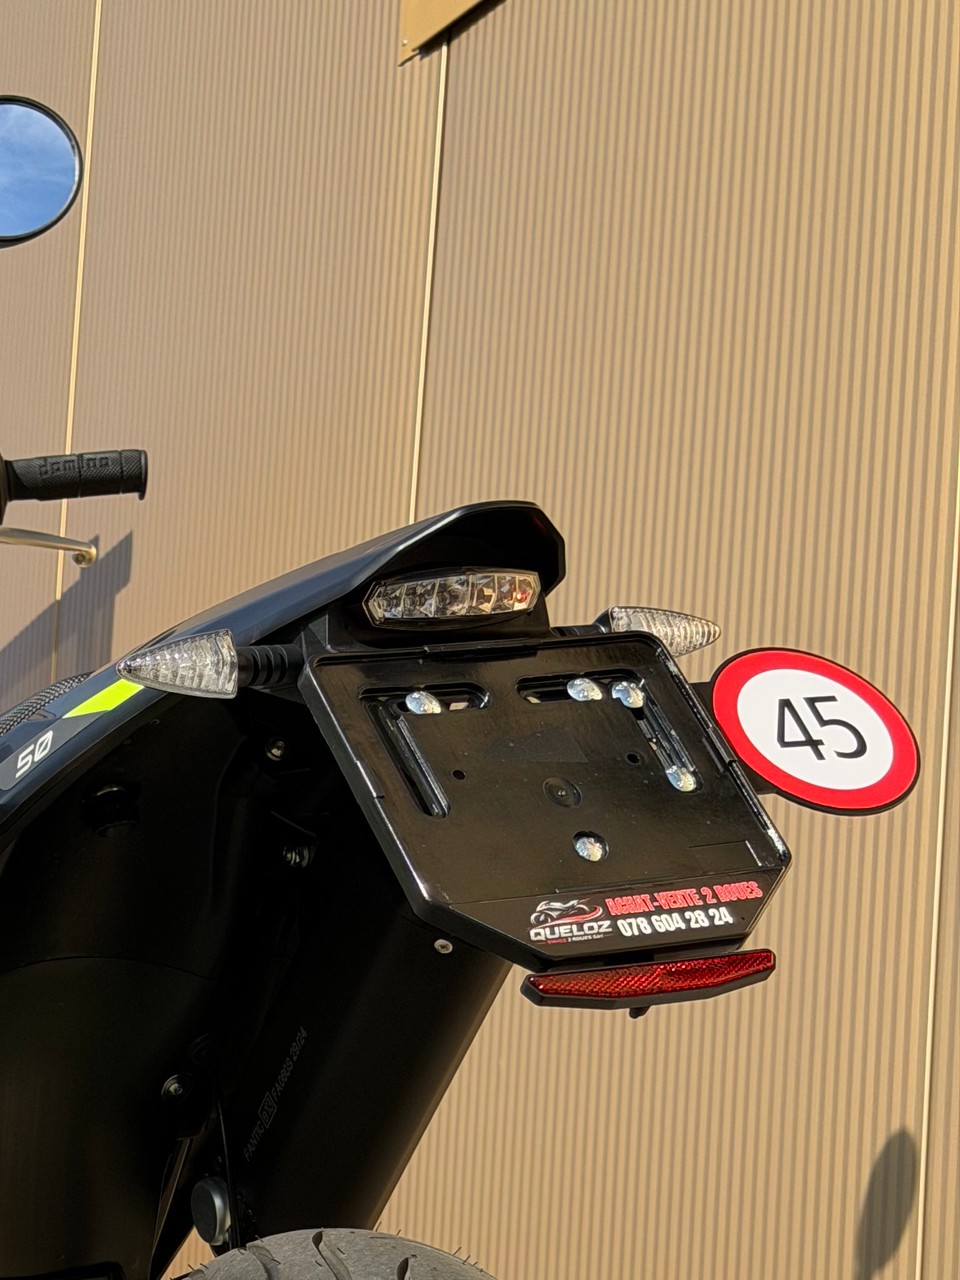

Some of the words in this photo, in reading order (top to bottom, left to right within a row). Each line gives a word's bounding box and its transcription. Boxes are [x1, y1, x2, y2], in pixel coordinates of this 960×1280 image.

[776, 695, 868, 761] 45
[15, 730, 54, 779] 50
[700, 887, 717, 904] 2
[714, 881, 763, 902] ROUES
[529, 920, 613, 942] QUELOZ
[617, 918, 652, 938] 078
[651, 914, 686, 934] 604
[685, 910, 710, 930] 28
[708, 906, 734, 926] 24
